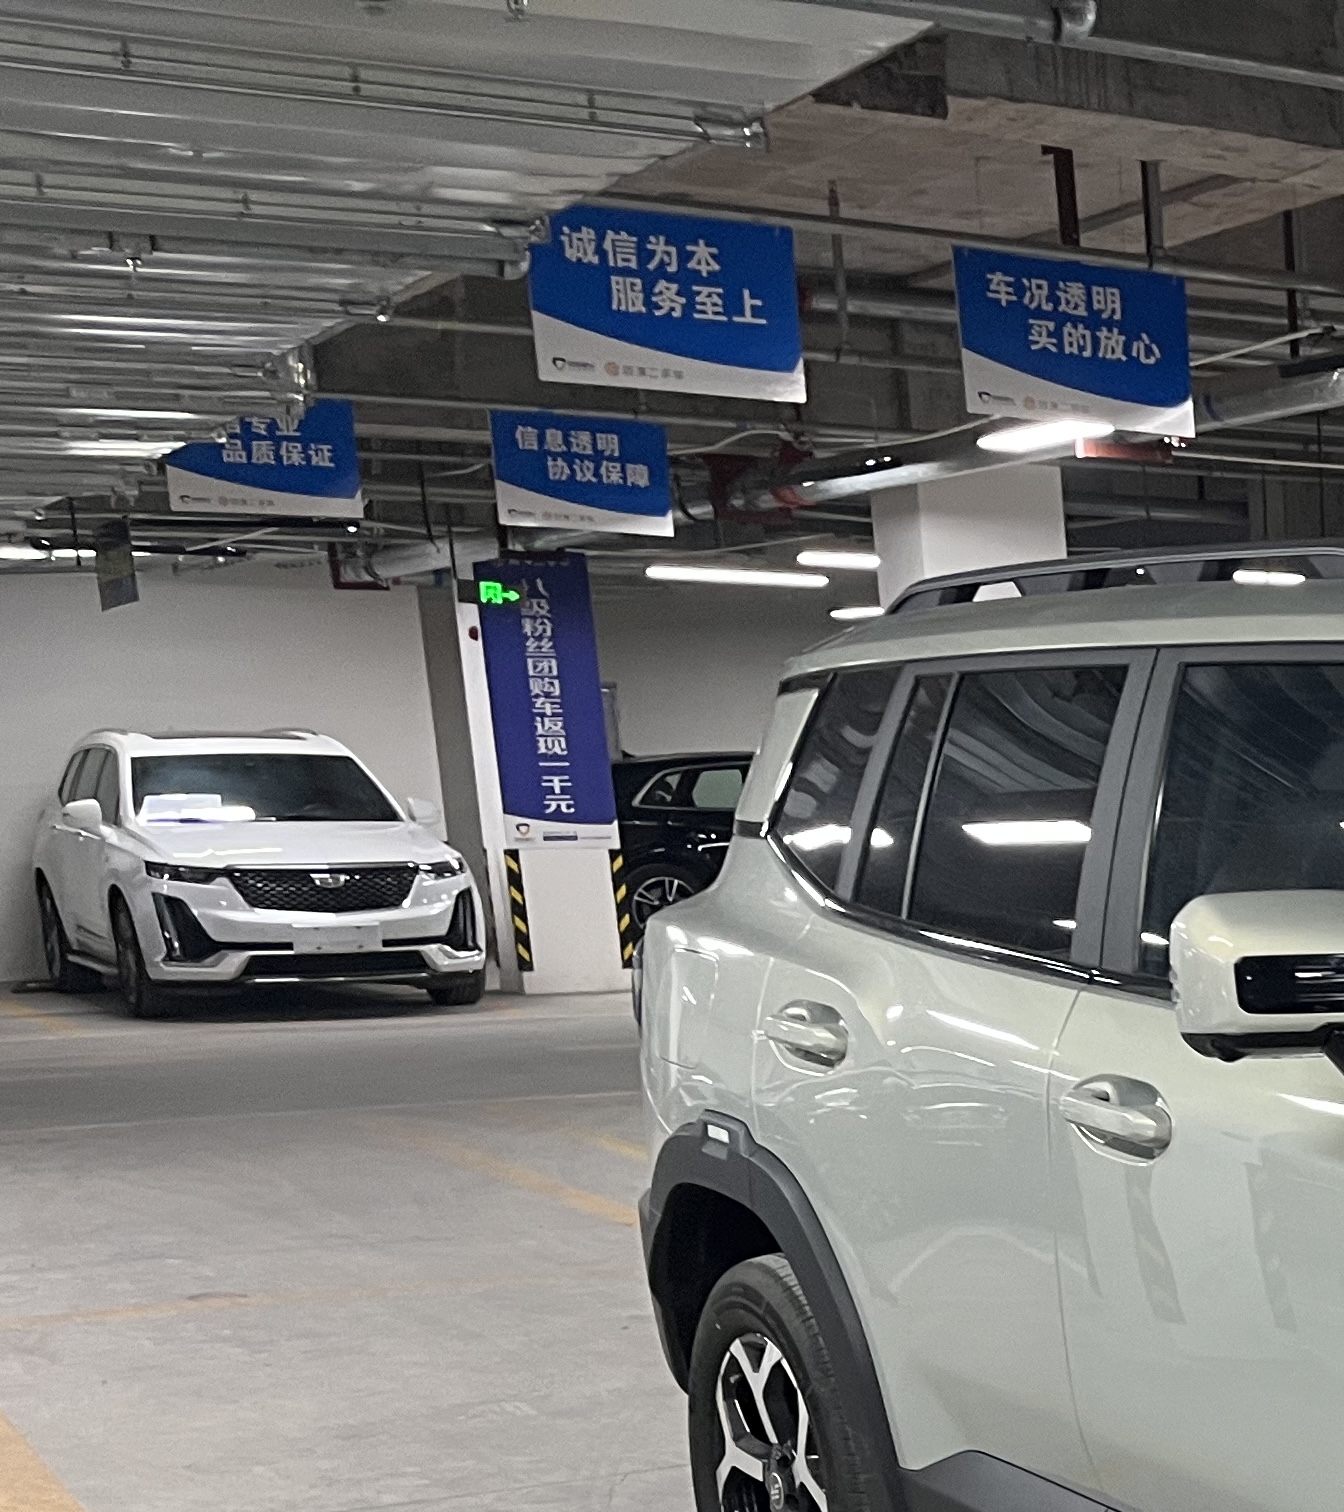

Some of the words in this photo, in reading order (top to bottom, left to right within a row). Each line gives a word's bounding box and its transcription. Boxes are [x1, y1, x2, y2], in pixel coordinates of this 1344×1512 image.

[560, 226, 721, 277] 诚信为本
[610, 275, 767, 324] 服务至上
[986, 272, 1123, 320] 车况透明
[1028, 318, 1161, 365] 买的放心
[222, 438, 335, 467] 品质保证
[515, 425, 620, 457] 信息透明
[547, 456, 650, 488] 协议保障
